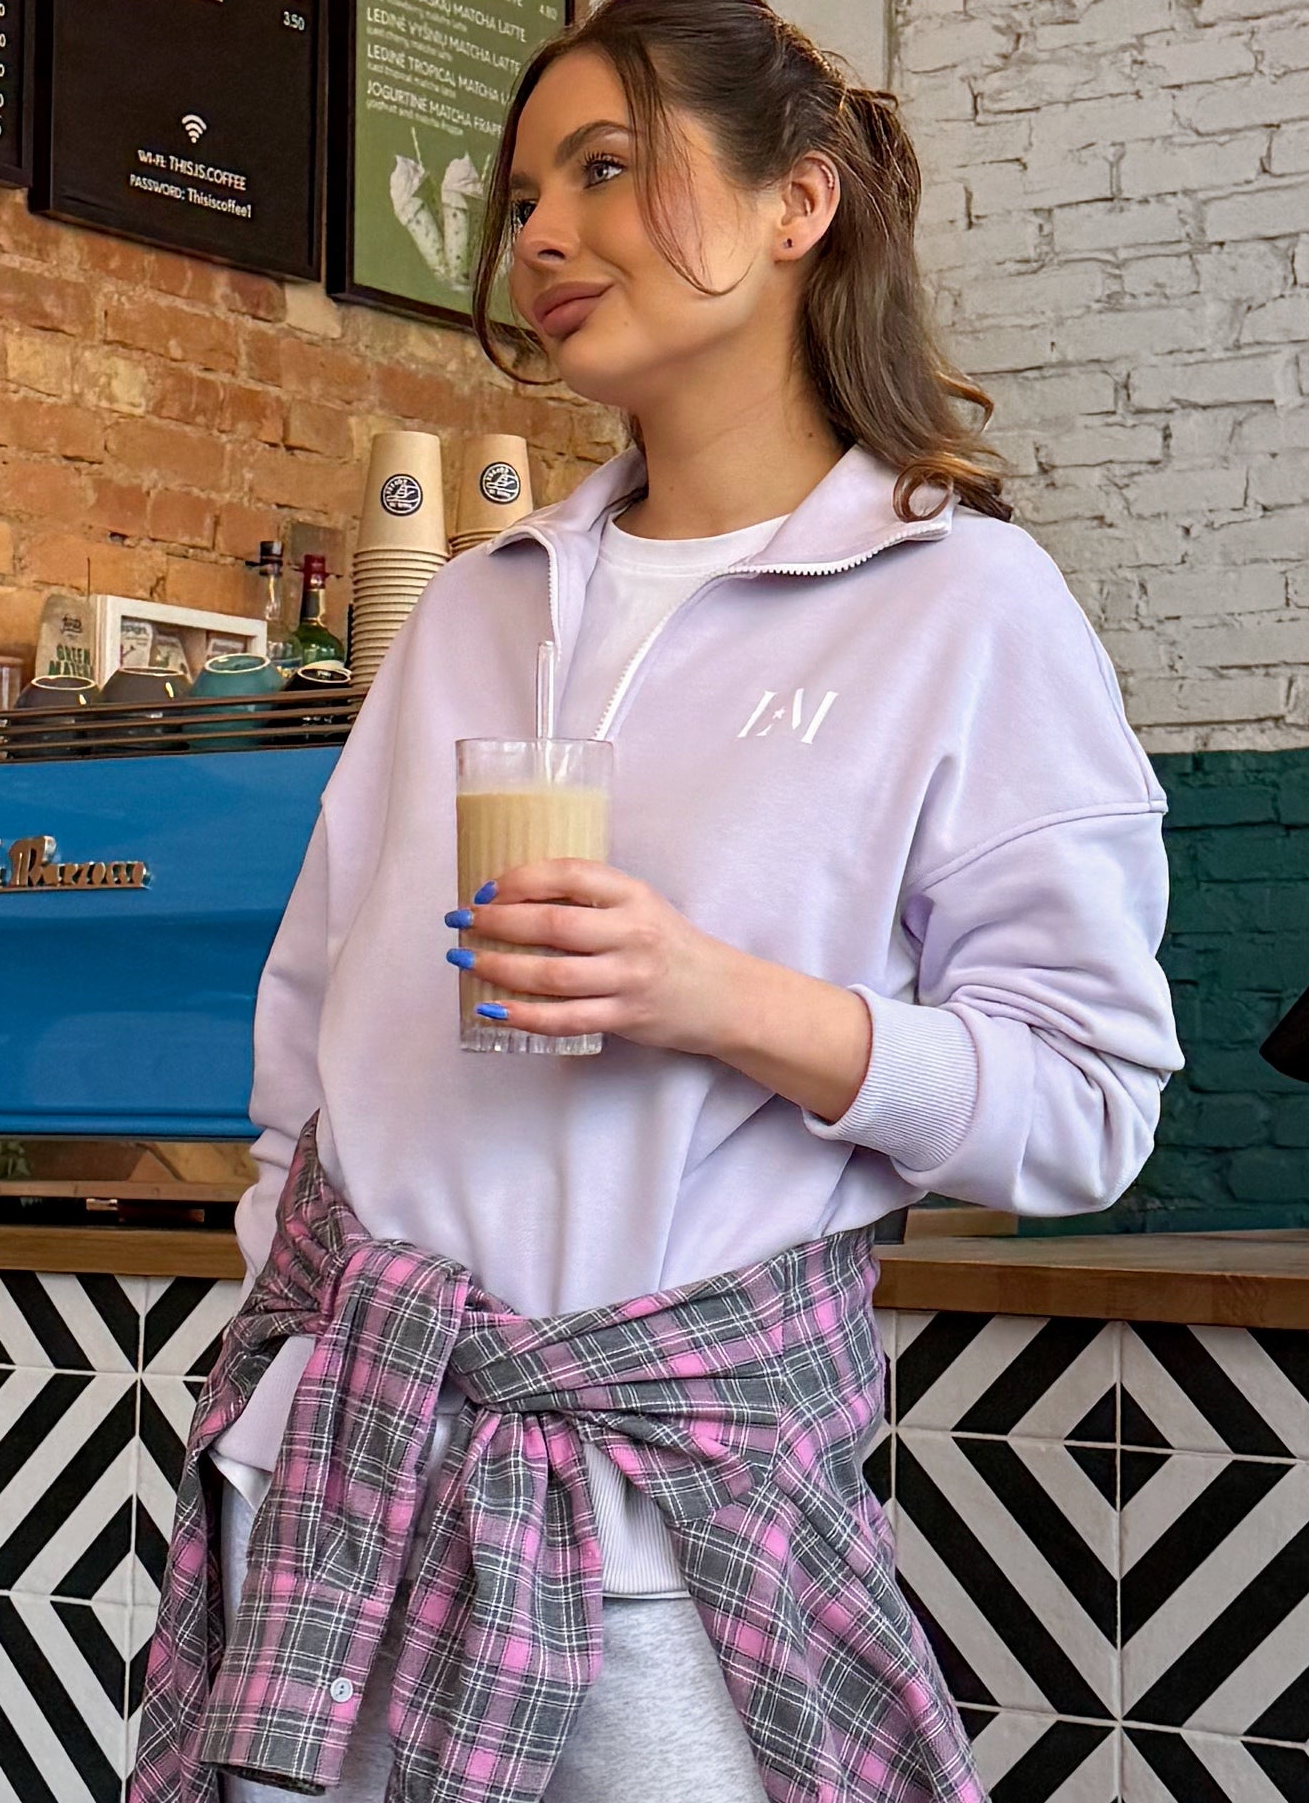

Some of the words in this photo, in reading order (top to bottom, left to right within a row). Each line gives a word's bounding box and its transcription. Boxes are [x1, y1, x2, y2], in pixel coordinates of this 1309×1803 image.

[283, 11, 305, 30] 3.50
[453, 3, 495, 31] MATCHA
[498, 19, 527, 43] LATTE
[449, 36, 492, 64] MATCHA
